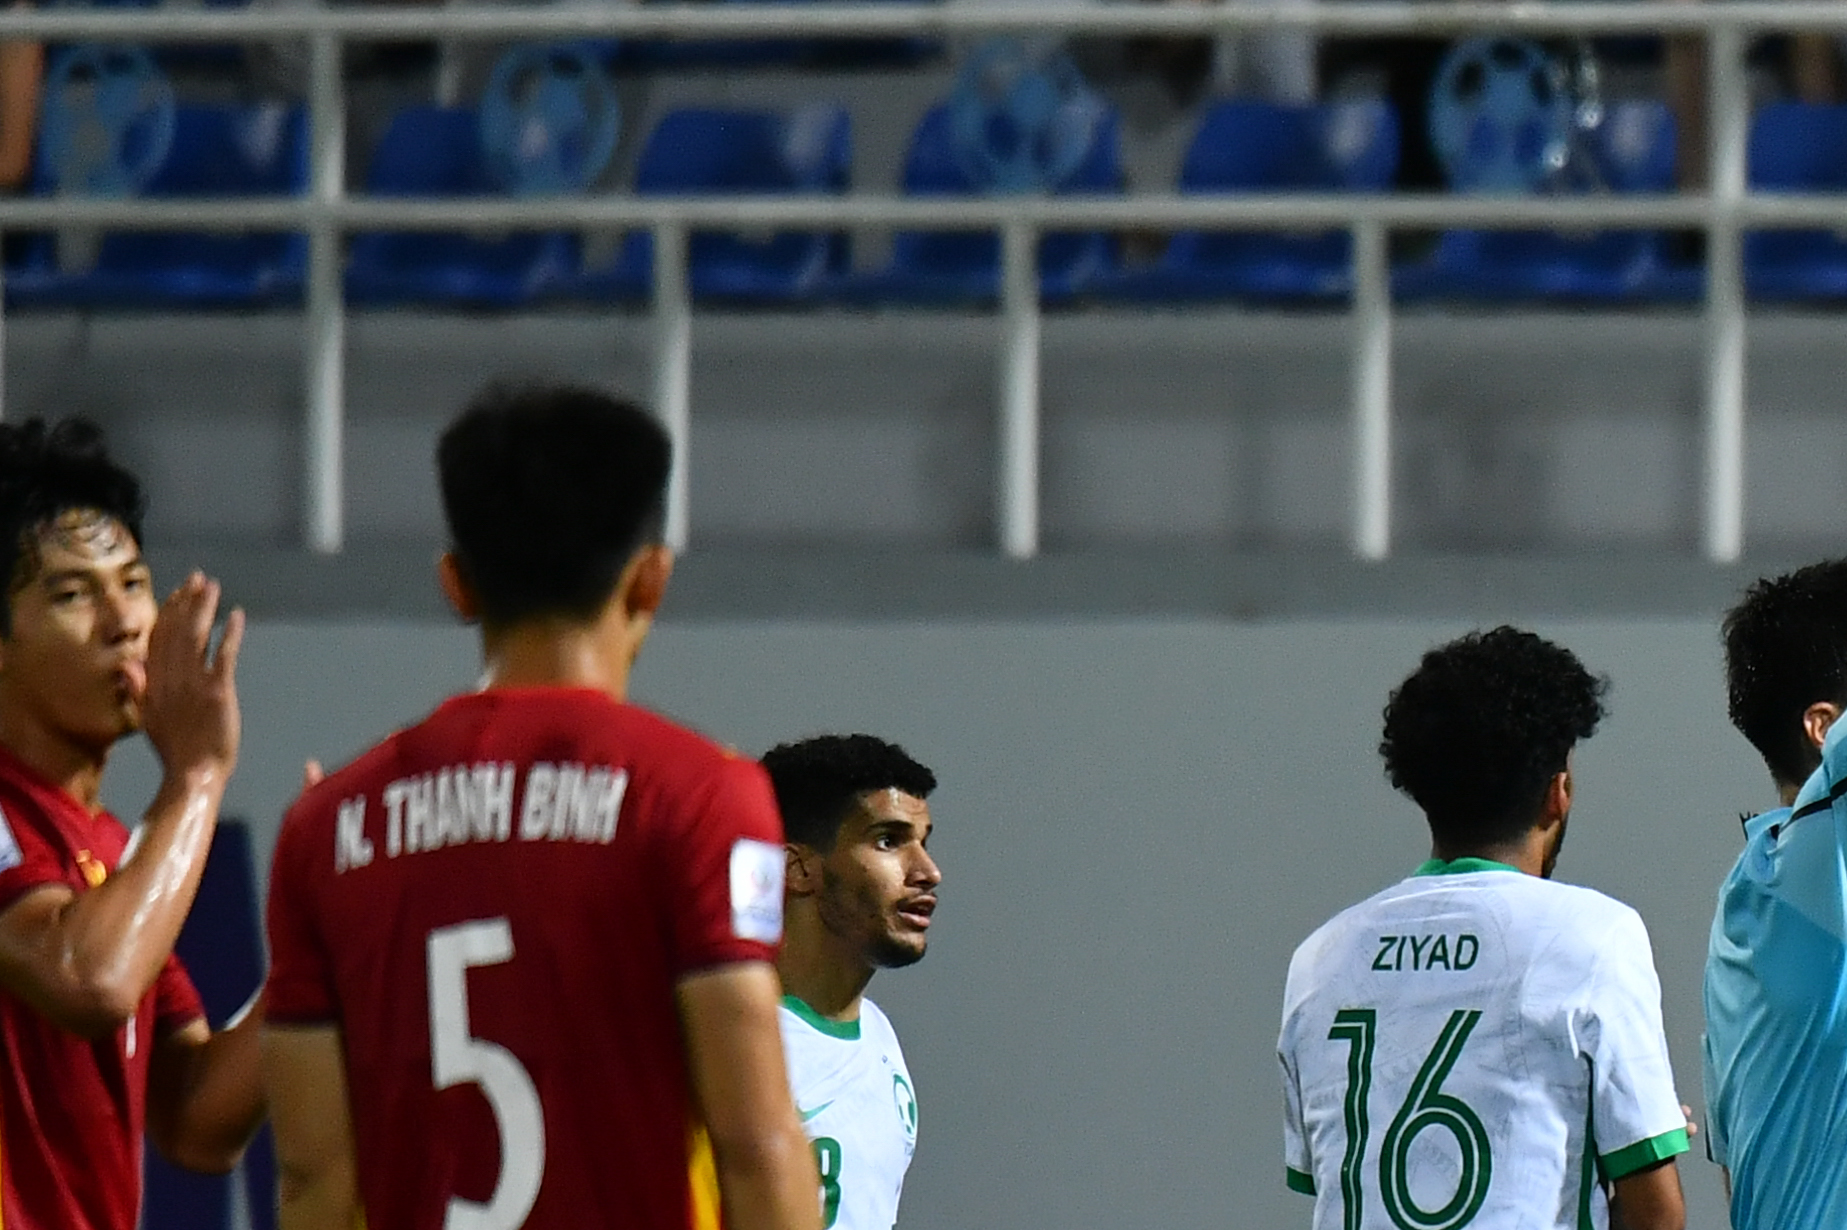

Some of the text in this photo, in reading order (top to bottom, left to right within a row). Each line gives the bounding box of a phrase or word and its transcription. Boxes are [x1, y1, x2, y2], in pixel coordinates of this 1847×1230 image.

[334, 760, 629, 874] N. THANH BINH
[1371, 934, 1479, 971] ZIYAD
